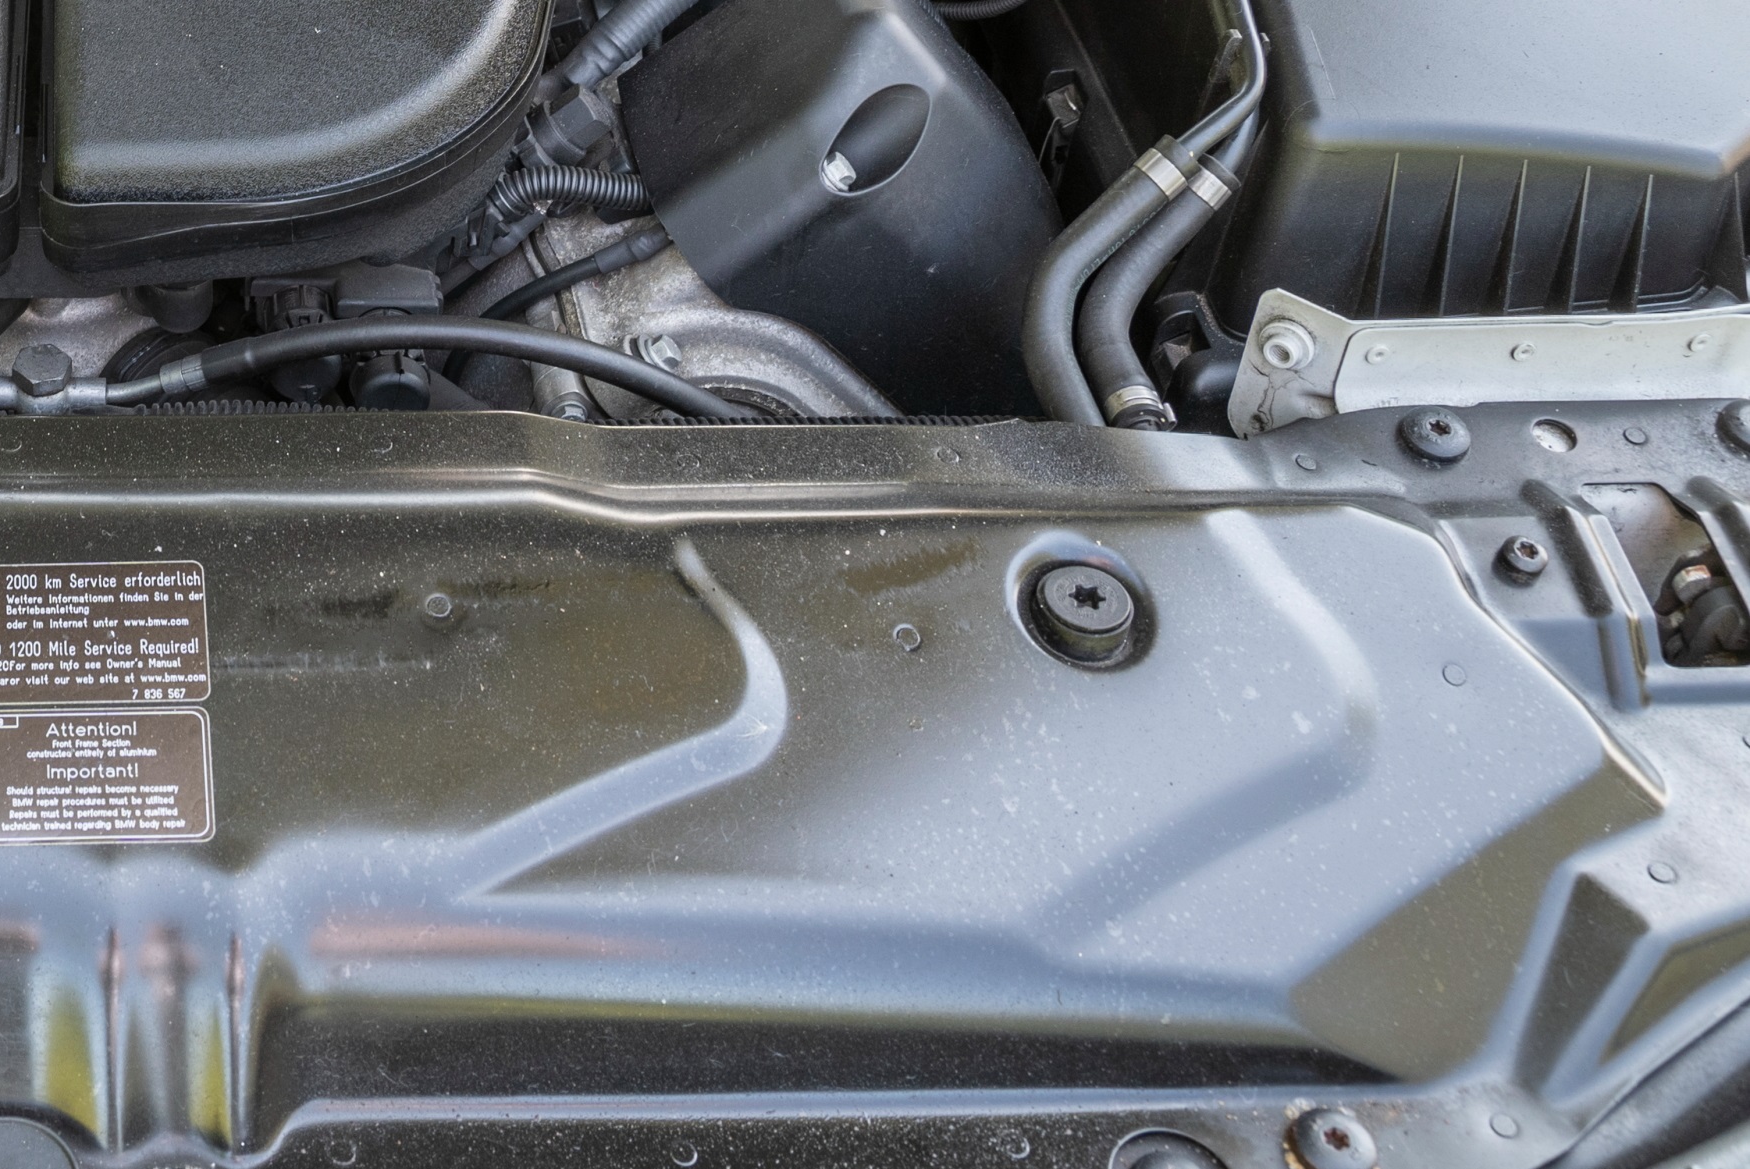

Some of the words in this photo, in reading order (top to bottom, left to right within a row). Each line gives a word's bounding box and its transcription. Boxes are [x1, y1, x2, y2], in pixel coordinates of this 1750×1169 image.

[6, 574, 37, 590] 2000
[45, 574, 61, 589] km
[70, 573, 116, 589] Service
[125, 571, 200, 587] erforderlich
[6, 595, 42, 604] Weitere
[49, 592, 114, 603] Informationen
[120, 593, 148, 602] finden
[154, 592, 169, 601] Sie
[175, 592, 183, 601] in
[189, 591, 203, 601] der
[6, 605, 90, 615] Betriebsanleitung
[6, 620, 27, 630] oder
[33, 620, 43, 629] im
[50, 619, 87, 629] Internet
[93, 618, 118, 628] unter
[124, 617, 189, 626] www.bmw.com
[9, 642, 41, 657] 1200
[49, 641, 76, 656] Mile
[85, 640, 132, 656] Service
[140, 638, 199, 657] Required!
[9, 661, 26, 671] For
[31, 661, 54, 670] more
[60, 660, 79, 672] info
[85, 660, 101, 669] see
[107, 658, 143, 669] Owner's
[149, 658, 181, 668] Manual
[9, 678, 20, 686] or
[26, 675, 49, 685] visit
[54, 676, 70, 685] our
[76, 674, 94, 684] web
[100, 674, 118, 683] site
[124, 674, 135, 683] at
[141, 674, 206, 683] www.bmw.com
[132, 689, 138, 700] 7
[144, 689, 163, 699] 836
[168, 688, 186, 698] 567
[46, 721, 137, 737] Attention!
[52, 740, 72, 748] Front
[75, 739, 98, 747] Frame
[102, 739, 131, 747] Section
[47, 763, 138, 781] Important!
[6, 786, 34, 795] Should
[105, 785, 136, 794] become
[140, 785, 179, 794] necessary
[12, 798, 33, 807] BMW
[37, 797, 58, 806] repair
[62, 796, 106, 807] procedures
[109, 796, 128, 805] must
[131, 795, 142, 804] be
[9, 809, 37, 820] Repairs
[41, 809, 60, 818] must
[63, 808, 74, 818] be
[77, 807, 118, 818] performed
[121, 807, 131, 818] by
[1, 822, 41, 831] technician
[74, 820, 111, 831] regarding
[115, 819, 136, 829] BMW
[140, 820, 160, 830] body
